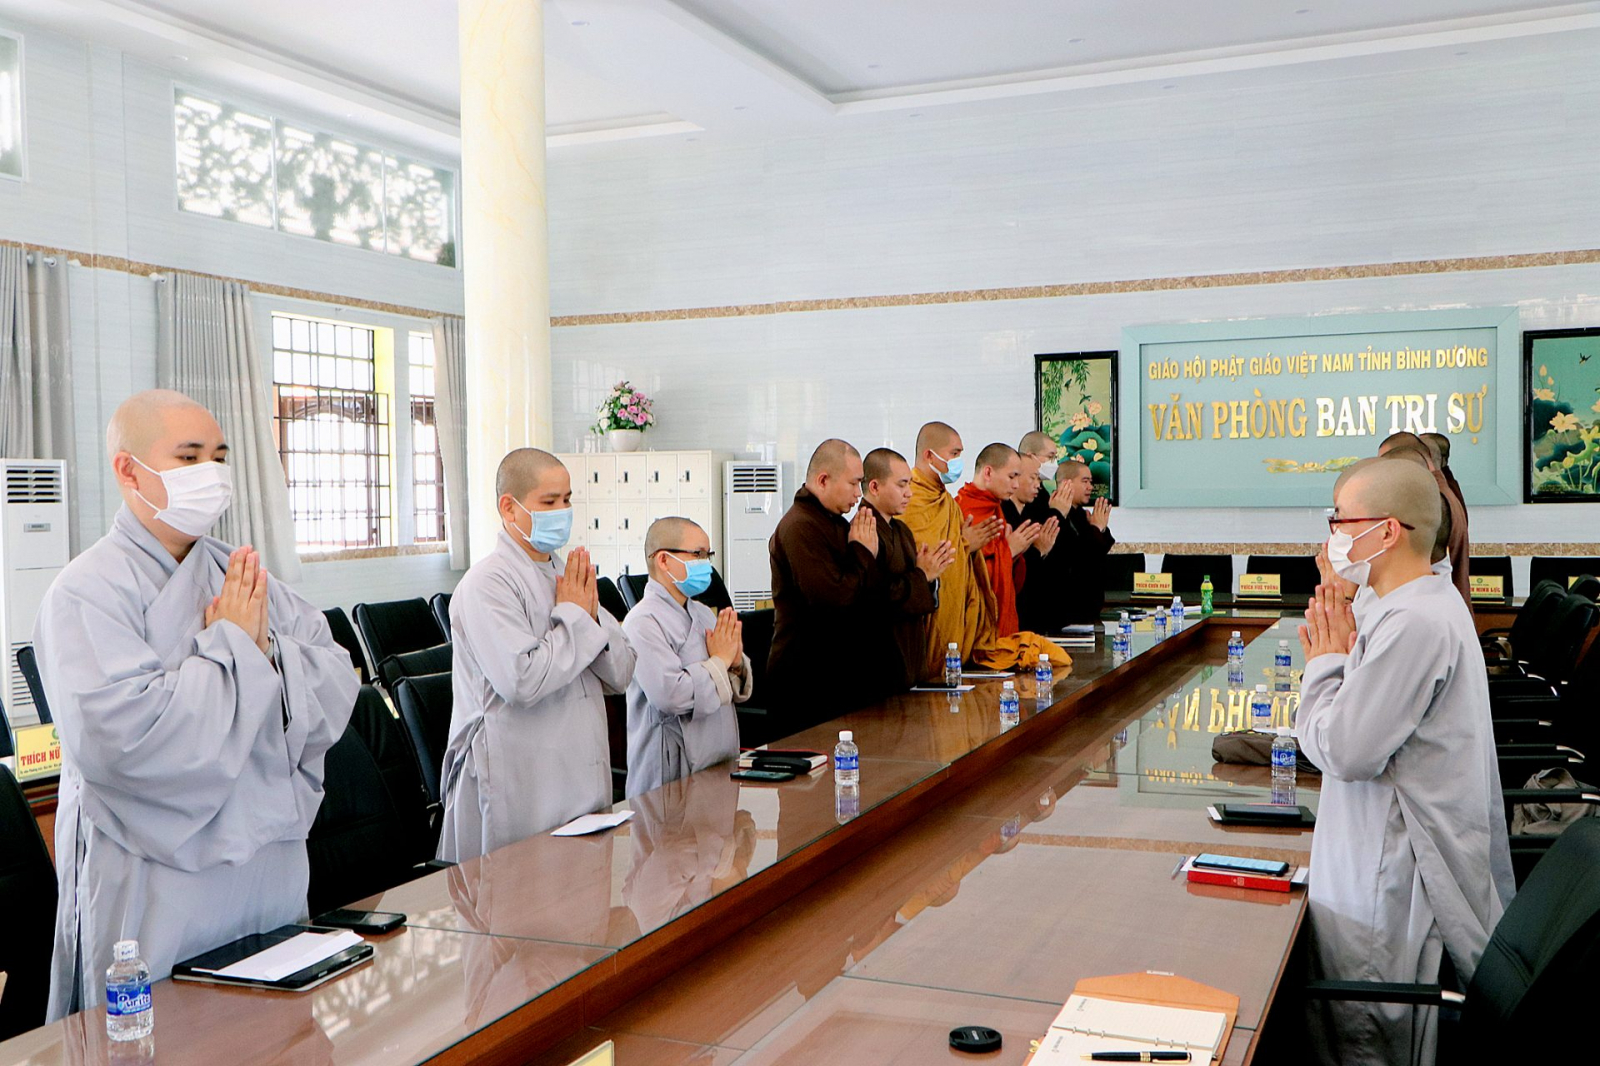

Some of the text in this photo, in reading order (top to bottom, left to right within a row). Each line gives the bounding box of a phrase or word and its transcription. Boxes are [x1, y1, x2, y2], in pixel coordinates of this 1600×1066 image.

[1148, 345, 1488, 383] GIÁO HỘI PHẬT GIÁO VIỆT NAM TỈNH BÌNH DƯƠNG
[1148, 384, 1488, 444] VĂN PHÒNG BAN TRI SỰ
[20, 750, 47, 767] THÍCH
